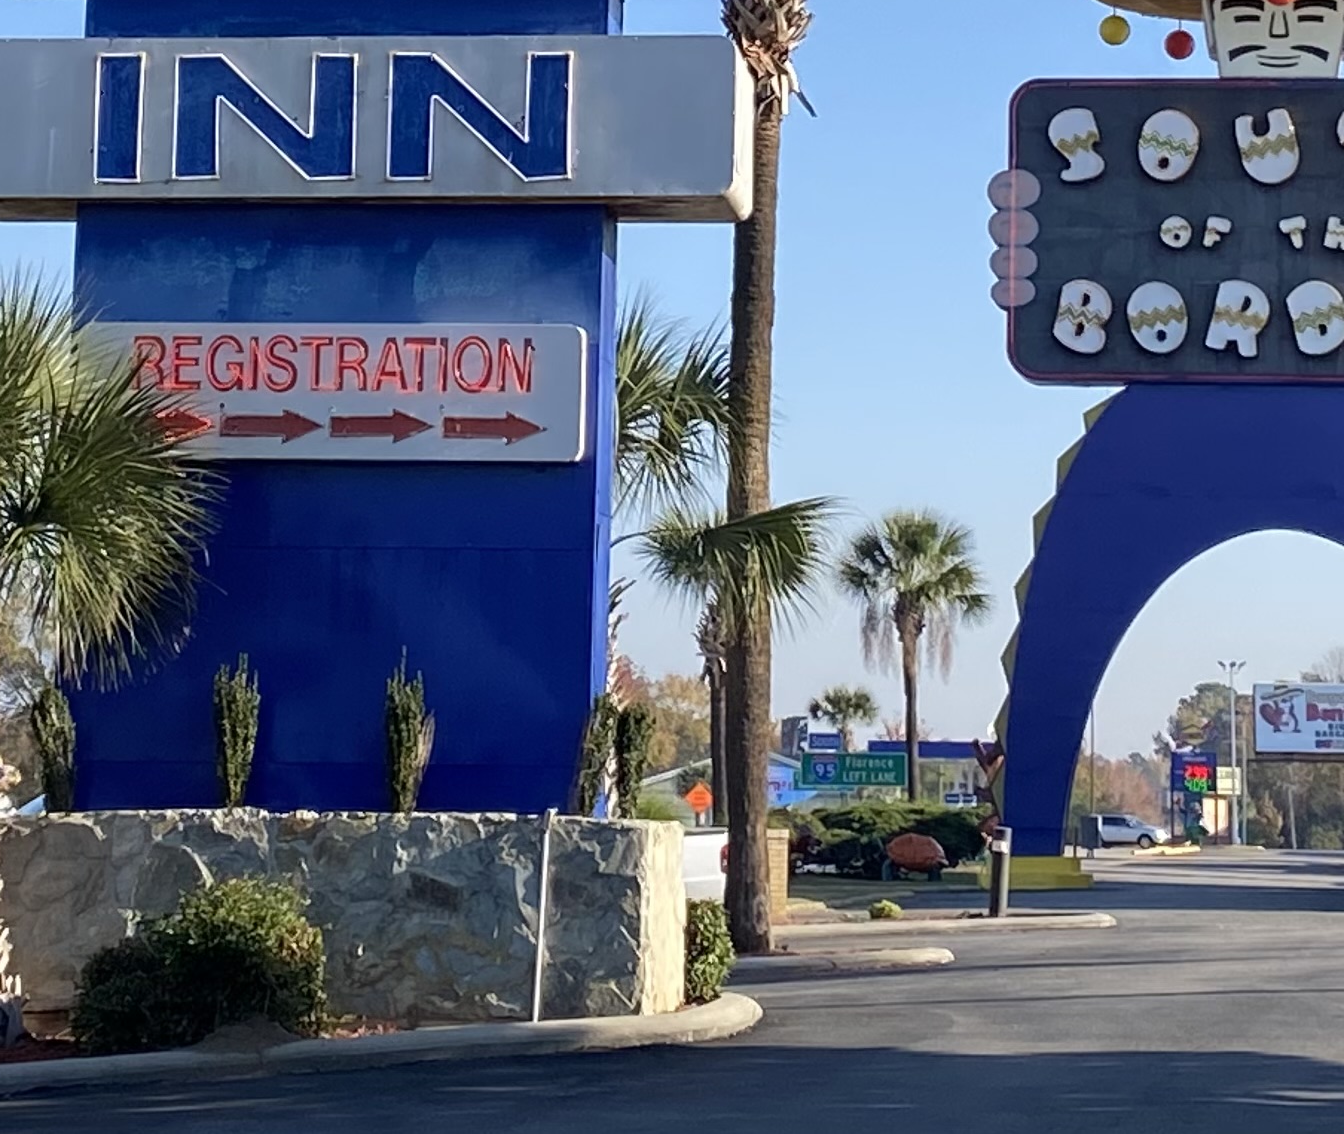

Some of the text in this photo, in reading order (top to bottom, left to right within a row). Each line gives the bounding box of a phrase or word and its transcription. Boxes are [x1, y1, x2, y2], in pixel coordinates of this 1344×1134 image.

[93, 51, 575, 183] INN
[1159, 215, 1232, 250] OF
[130, 334, 536, 394] REGISTRATION
[815, 763, 836, 777] 95
[845, 756, 894, 769] Florence
[842, 770, 897, 783] LEFT LANE
